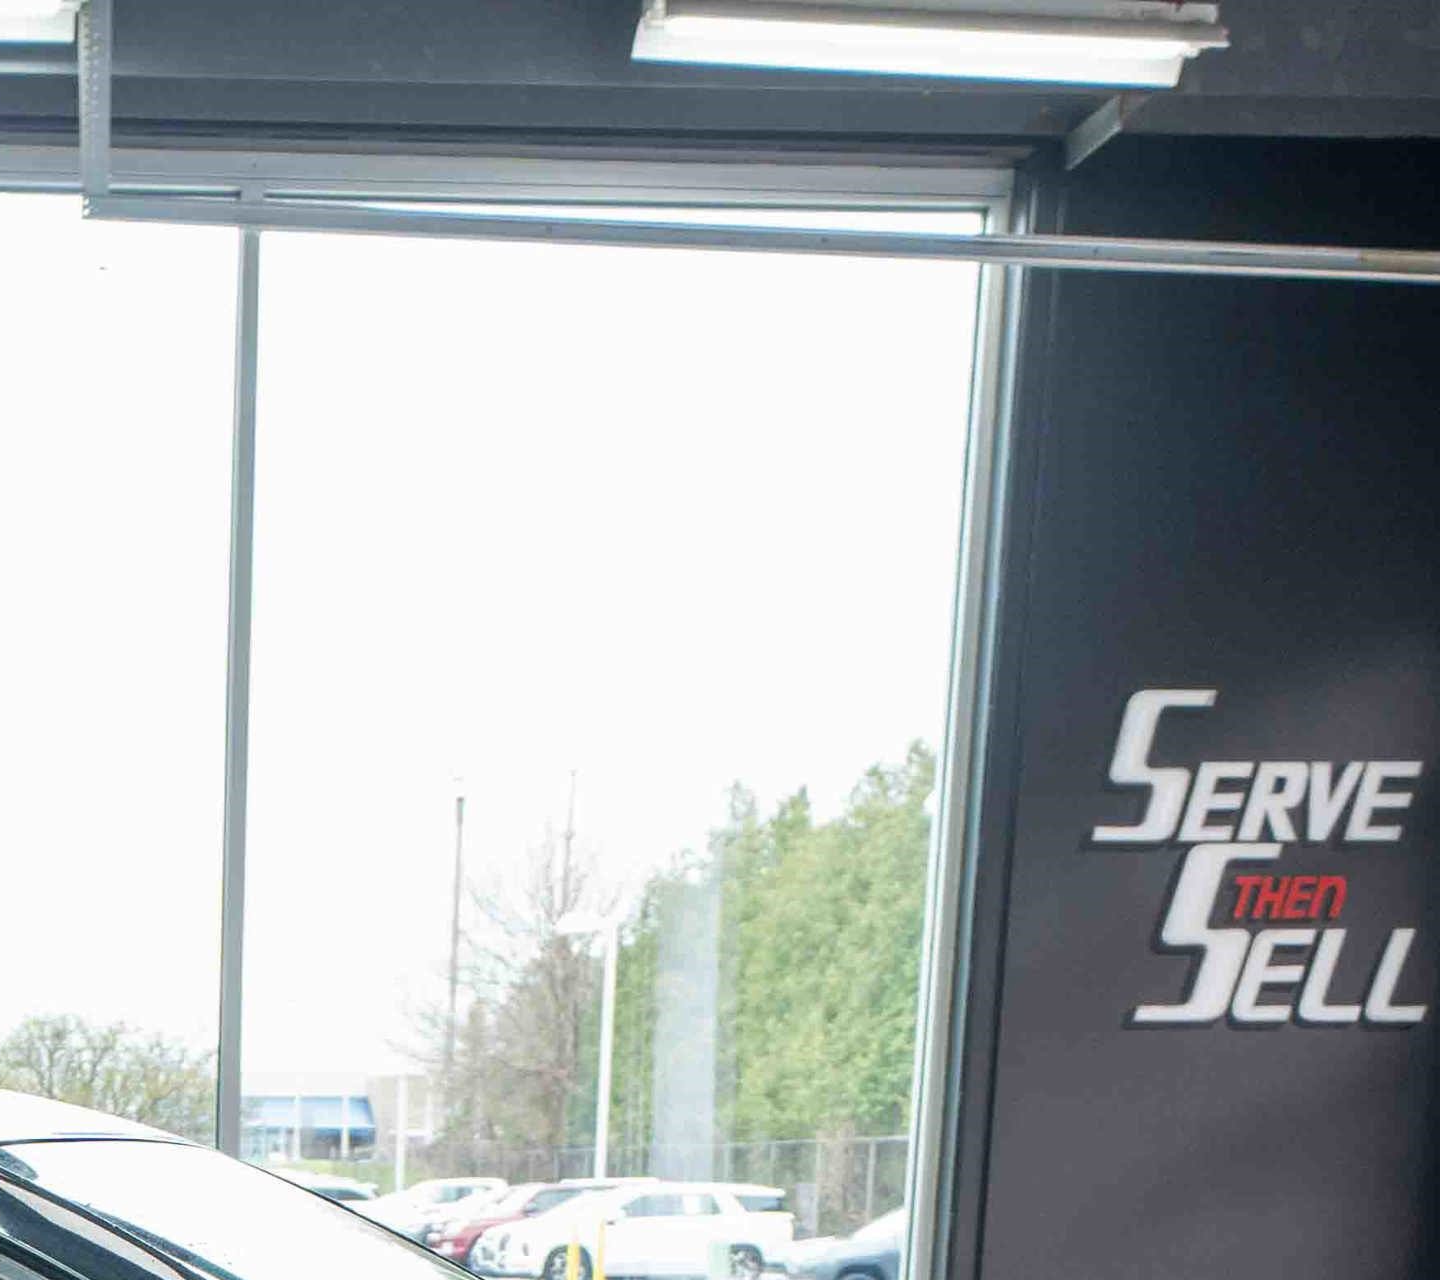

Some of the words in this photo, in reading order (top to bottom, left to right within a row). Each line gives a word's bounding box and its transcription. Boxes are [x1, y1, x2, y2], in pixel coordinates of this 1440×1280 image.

[1091, 688, 1424, 842] SERVE
[1133, 843, 1428, 1023] SELL
[1232, 875, 1348, 920] THEN
